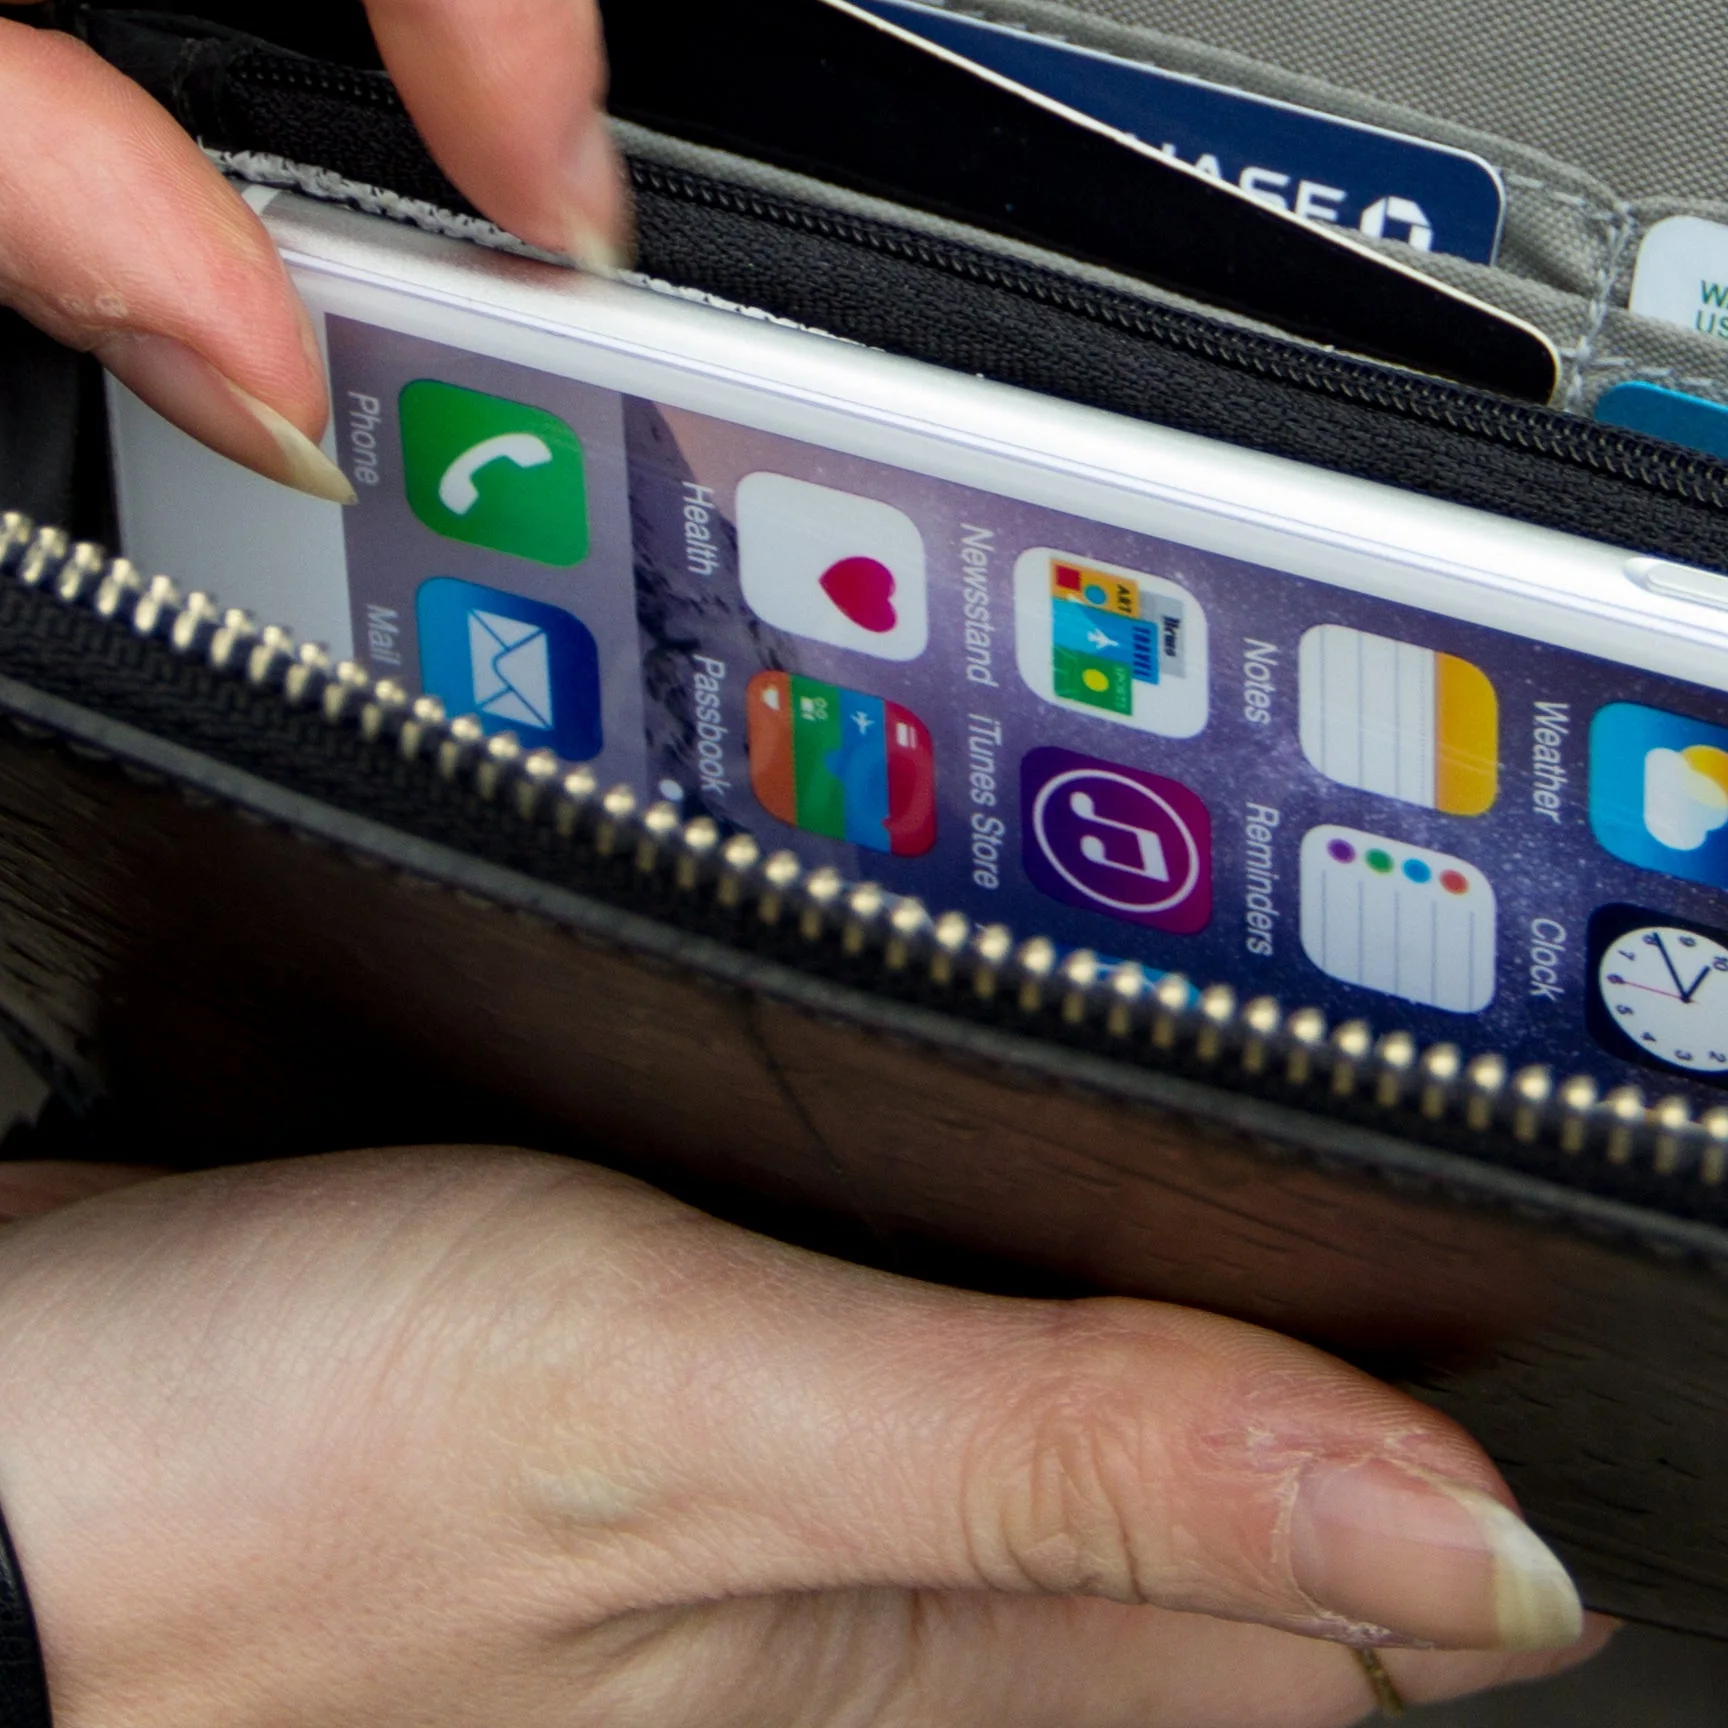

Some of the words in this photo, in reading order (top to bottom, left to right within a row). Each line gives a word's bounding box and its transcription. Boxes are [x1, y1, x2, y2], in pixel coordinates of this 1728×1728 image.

[347, 390, 382, 487] Phone
[681, 480, 721, 577] Health
[366, 602, 402, 666] Mail
[959, 521, 1000, 689] Newsstand
[1116, 583, 1133, 614] ART
[692, 653, 732, 797] Passbook
[1242, 636, 1281, 726] Notes
[968, 712, 1003, 808] iTunes
[1532, 700, 1570, 824] Weather
[970, 811, 1007, 892] Store
[1245, 801, 1281, 958] Reminders
[1529, 917, 1567, 1003] Clock
[1617, 950, 1636, 961] 7
[1678, 936, 1696, 947] 9
[1675, 1049, 1693, 1061] 3
[1708, 1050, 1727, 1062] 2
